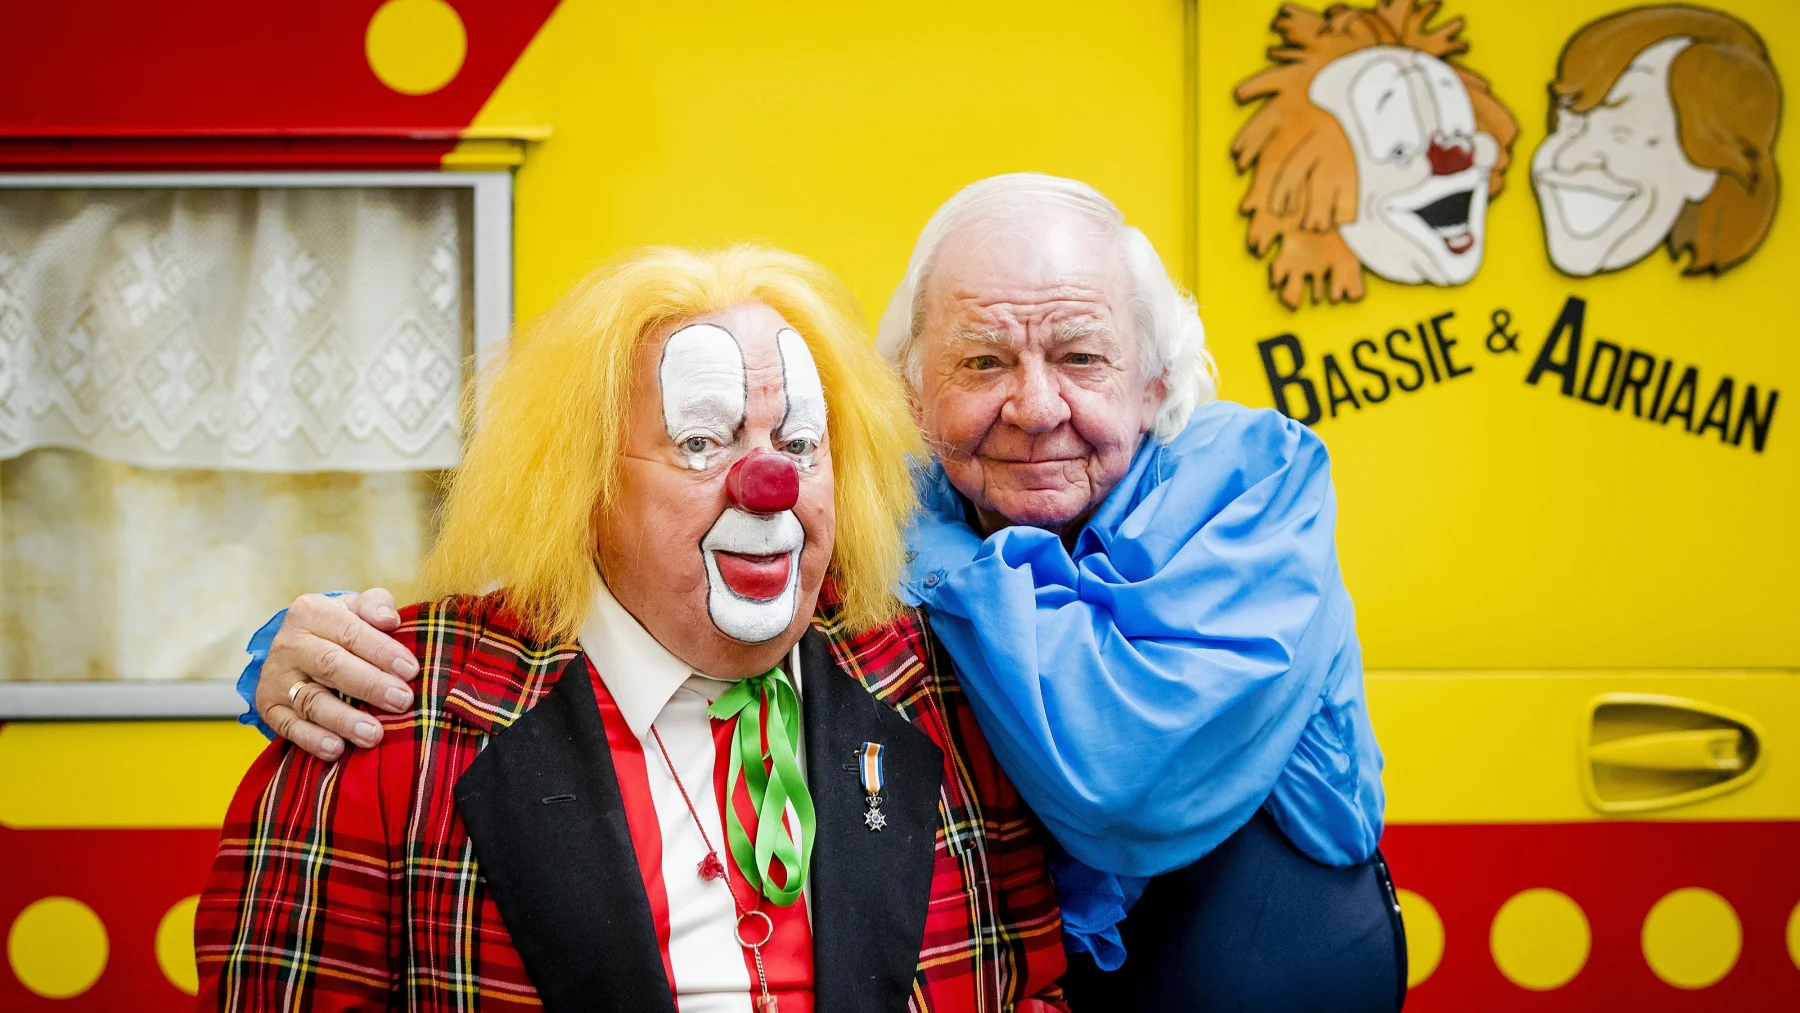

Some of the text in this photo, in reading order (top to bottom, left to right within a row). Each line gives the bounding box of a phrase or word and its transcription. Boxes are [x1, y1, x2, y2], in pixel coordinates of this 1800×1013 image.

[1257, 296, 1779, 453] BASSIE & ADRIAAN
